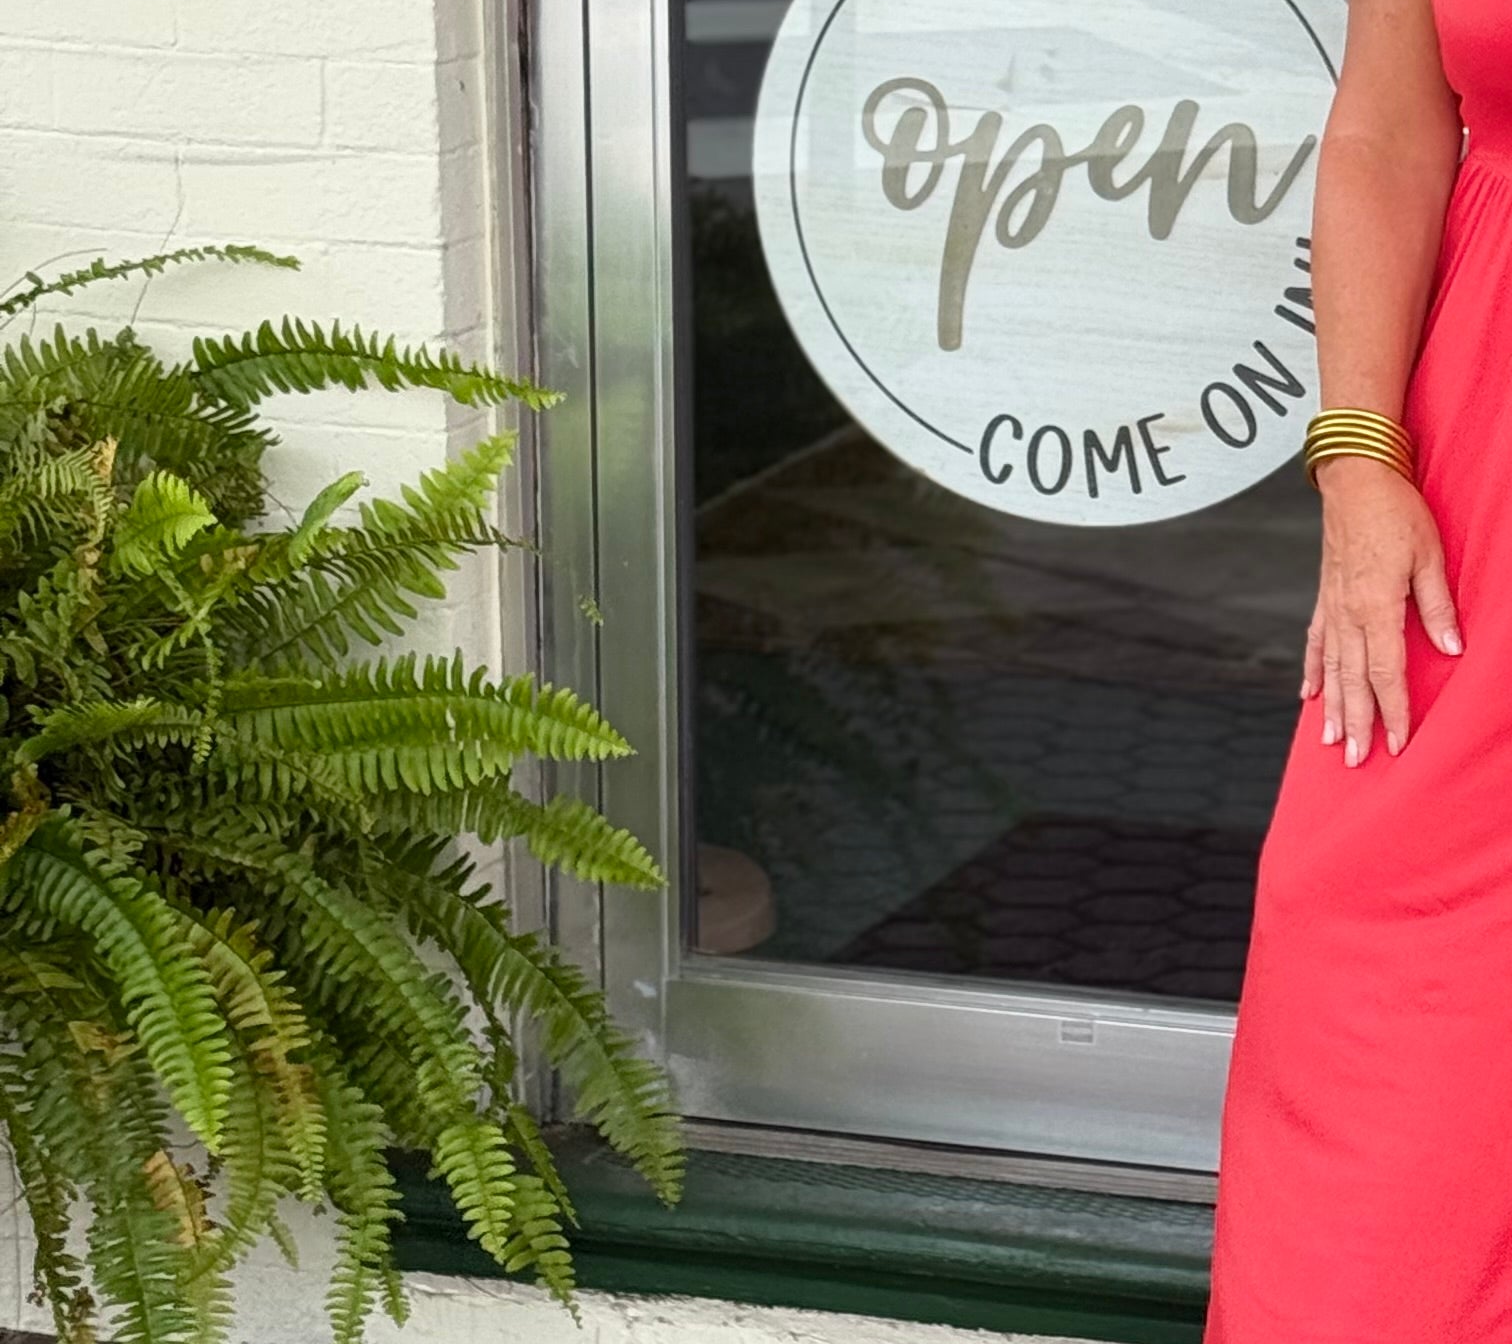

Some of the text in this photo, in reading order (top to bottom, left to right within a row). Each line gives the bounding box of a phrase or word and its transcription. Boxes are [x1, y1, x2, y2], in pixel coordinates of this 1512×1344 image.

[861, 77, 1318, 352] open
[979, 340, 1306, 498] COME ON
